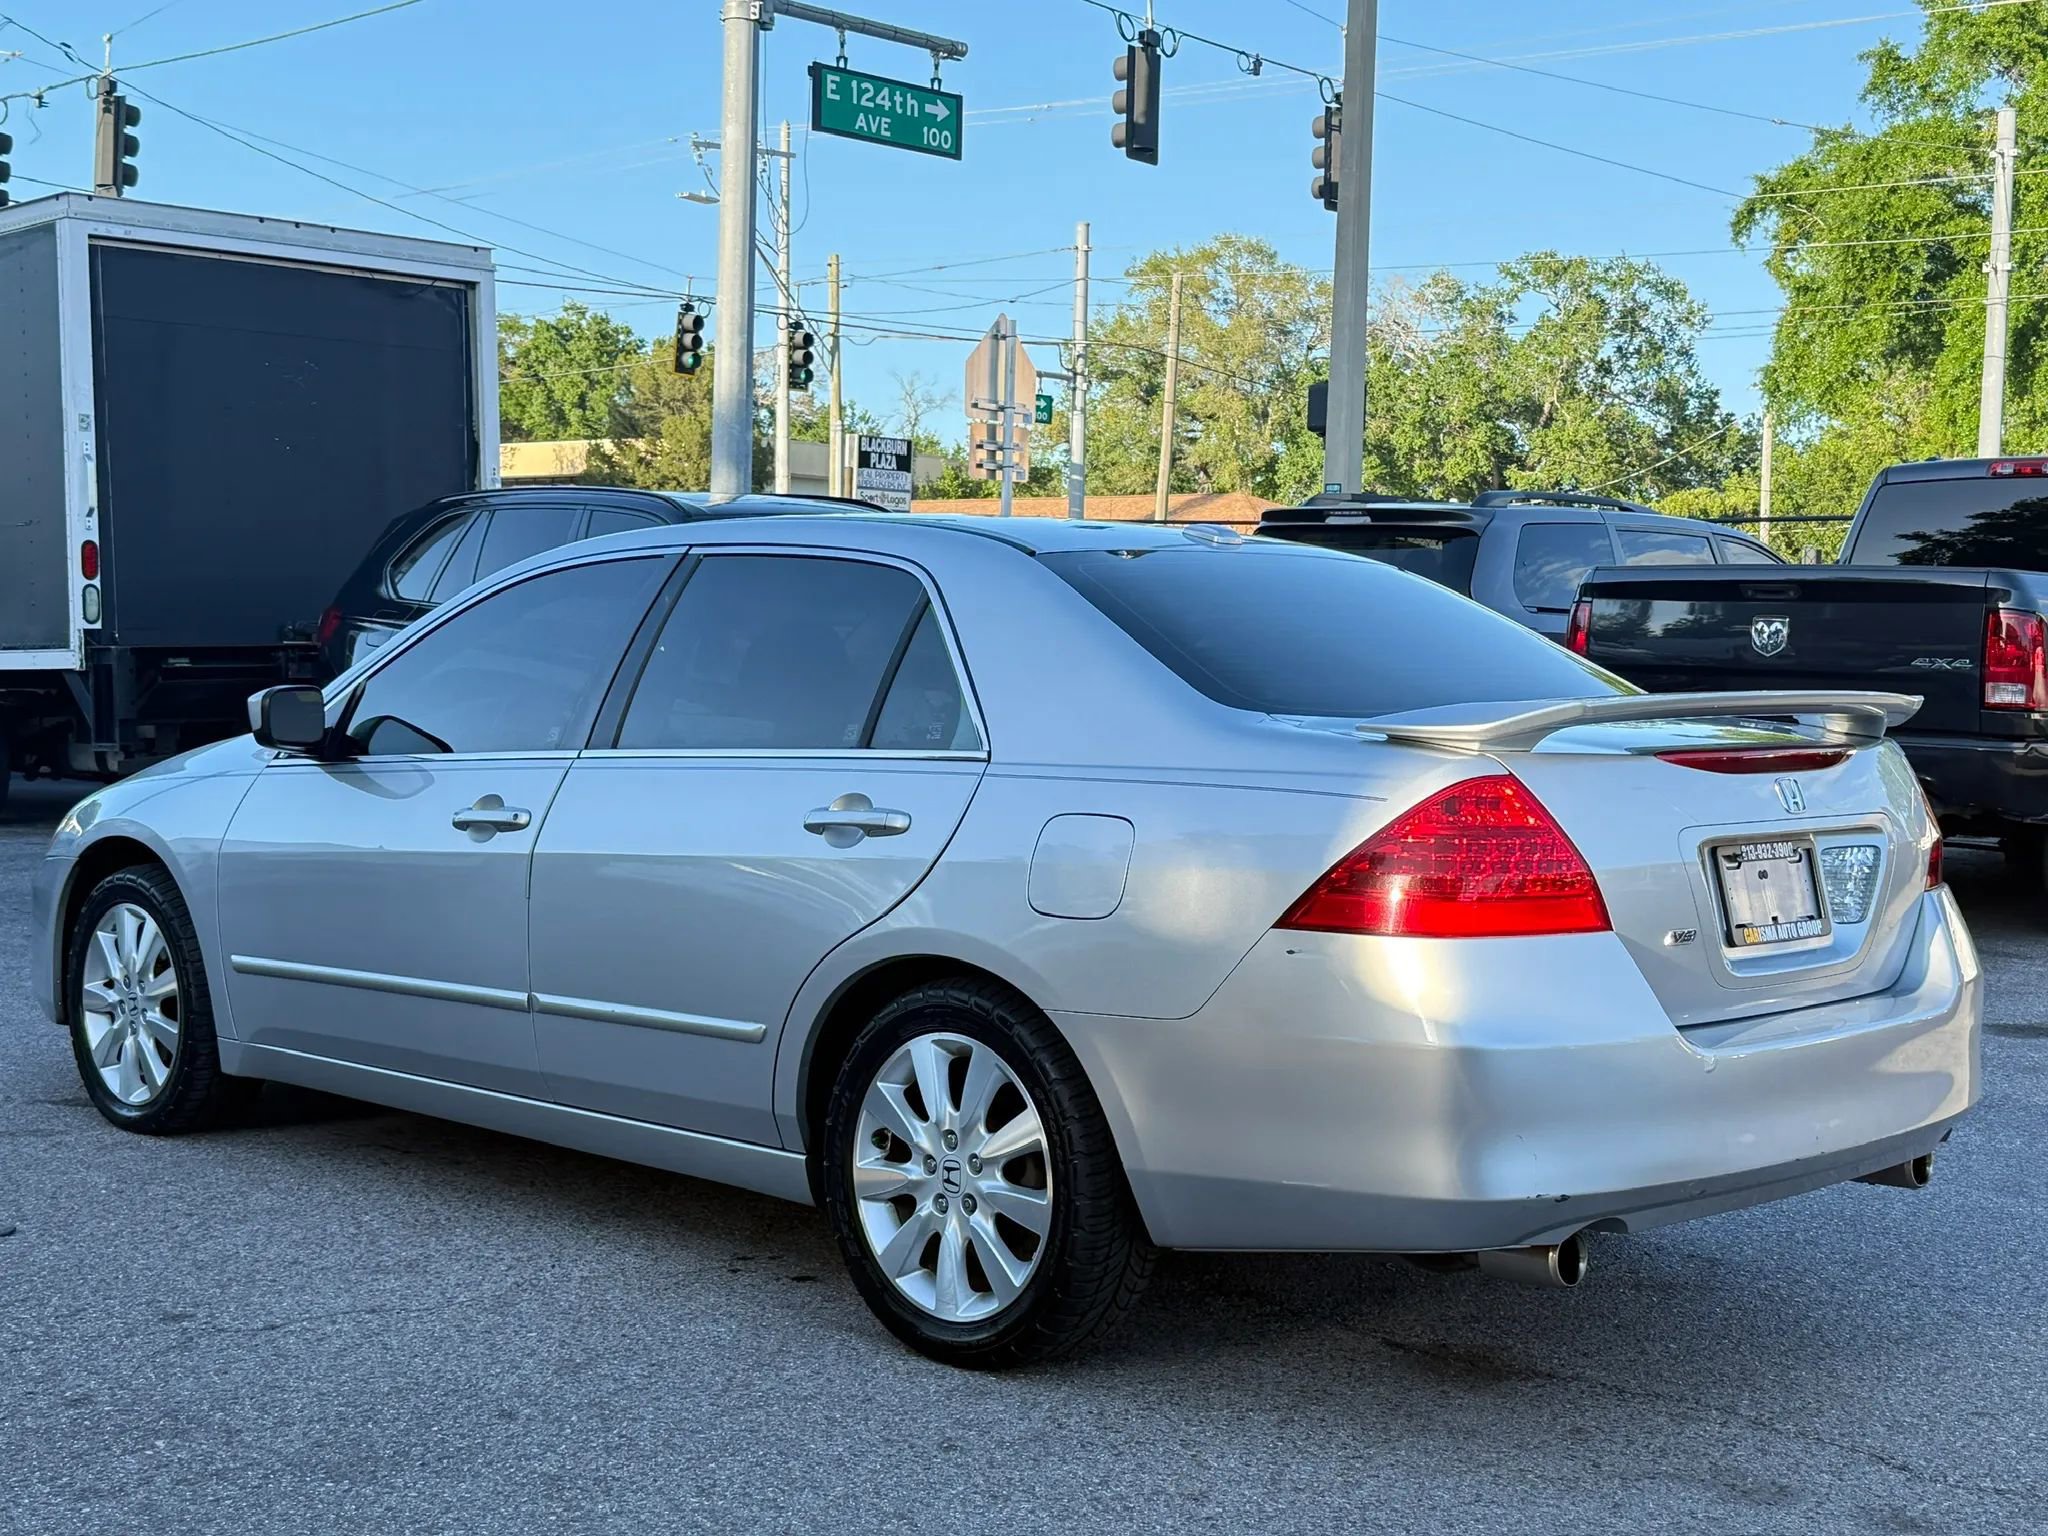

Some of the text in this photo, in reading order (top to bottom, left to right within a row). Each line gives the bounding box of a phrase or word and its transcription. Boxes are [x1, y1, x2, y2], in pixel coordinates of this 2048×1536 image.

[826, 74, 919, 117] E 124th
[855, 113, 891, 137] AVE
[923, 126, 952, 149] 100
[861, 436, 908, 456] BLACKBURN
[870, 452, 897, 470] PLAZA
[887, 492, 907, 508] Logos
[1743, 920, 1823, 944] CARISMA AUTO GROUP
